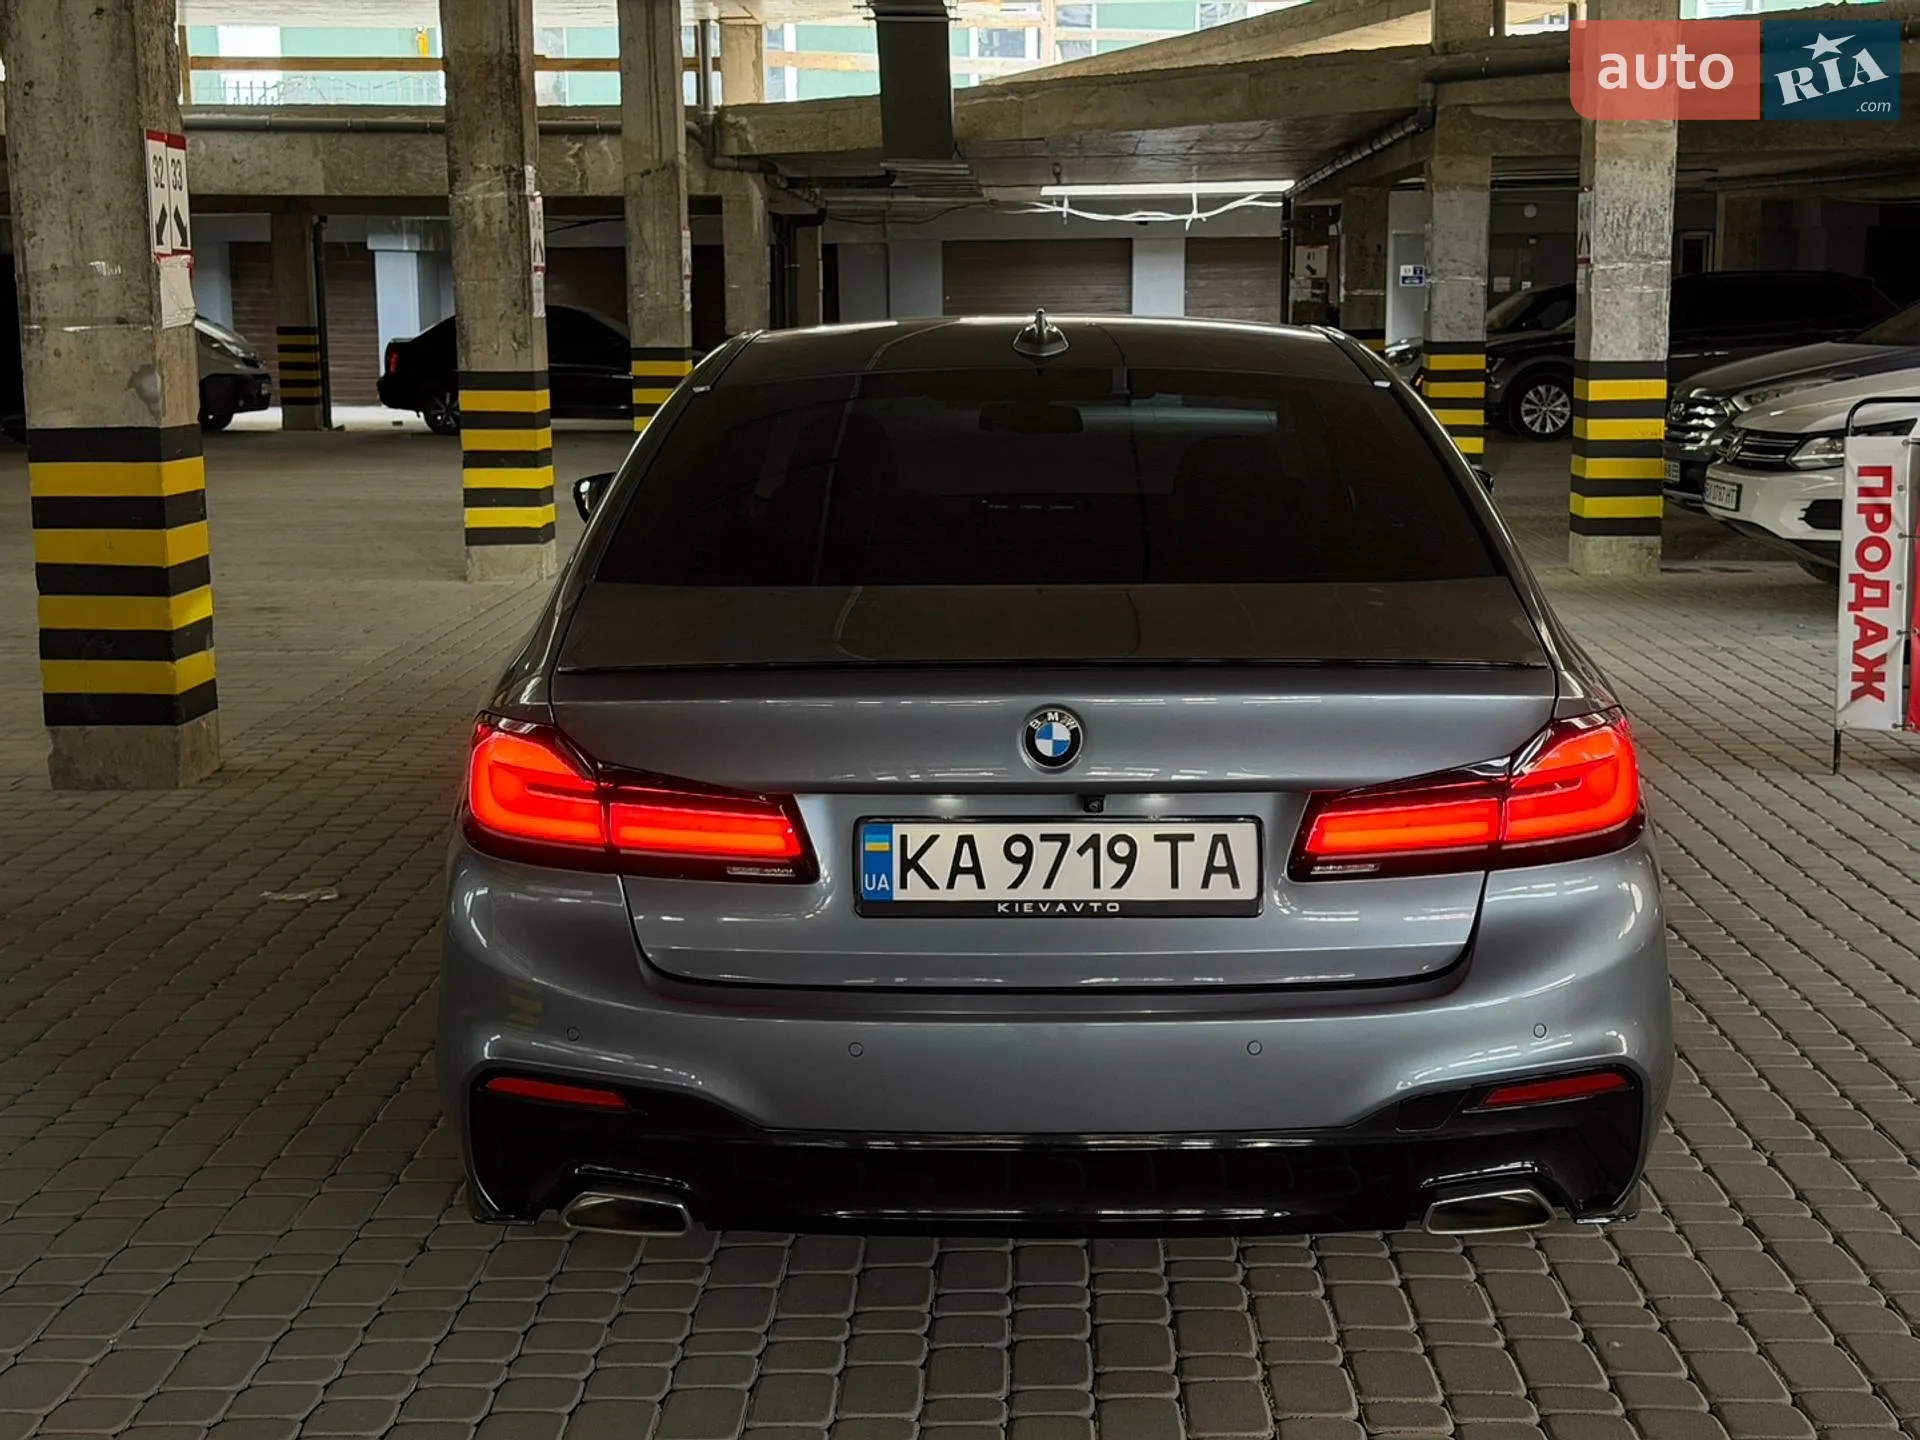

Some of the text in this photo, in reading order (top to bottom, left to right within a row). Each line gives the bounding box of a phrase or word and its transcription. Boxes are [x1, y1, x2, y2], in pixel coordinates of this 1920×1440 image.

[152, 155, 165, 189] 32
[170, 158, 183, 192] 33
[1847, 465, 1893, 703] ПРОДАЖ
[1029, 711, 1078, 730] BMW
[899, 833, 1242, 890] KA 9719 TA
[865, 874, 890, 891] UA
[997, 902, 1120, 913] KIEVAVTO
